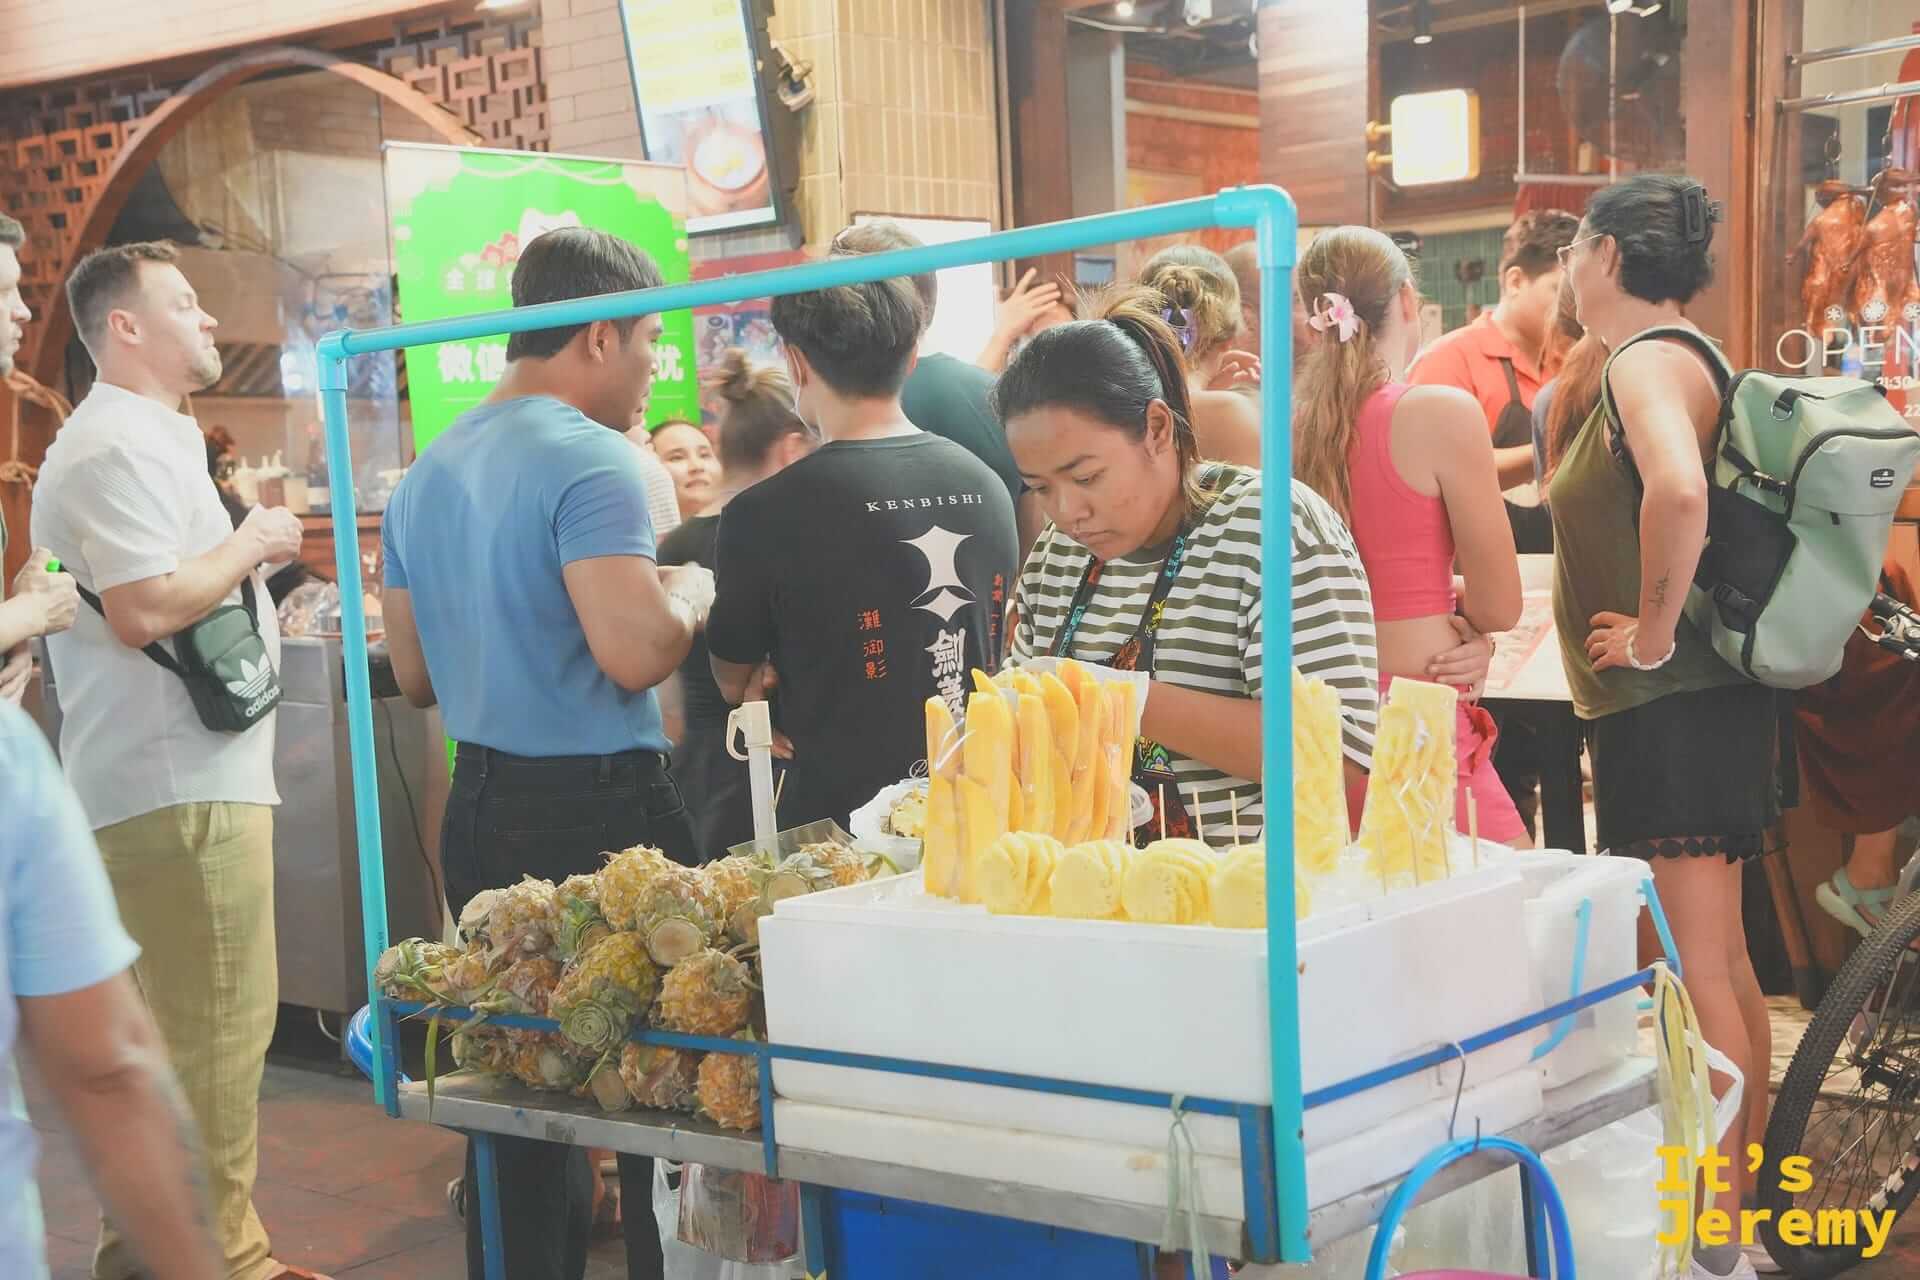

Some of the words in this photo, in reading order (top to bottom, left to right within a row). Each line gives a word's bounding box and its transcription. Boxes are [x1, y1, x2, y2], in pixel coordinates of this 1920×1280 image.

[1776, 326, 1920, 368] OPEN
[865, 494, 983, 512] KENBISHI
[245, 685, 280, 717] adidas
